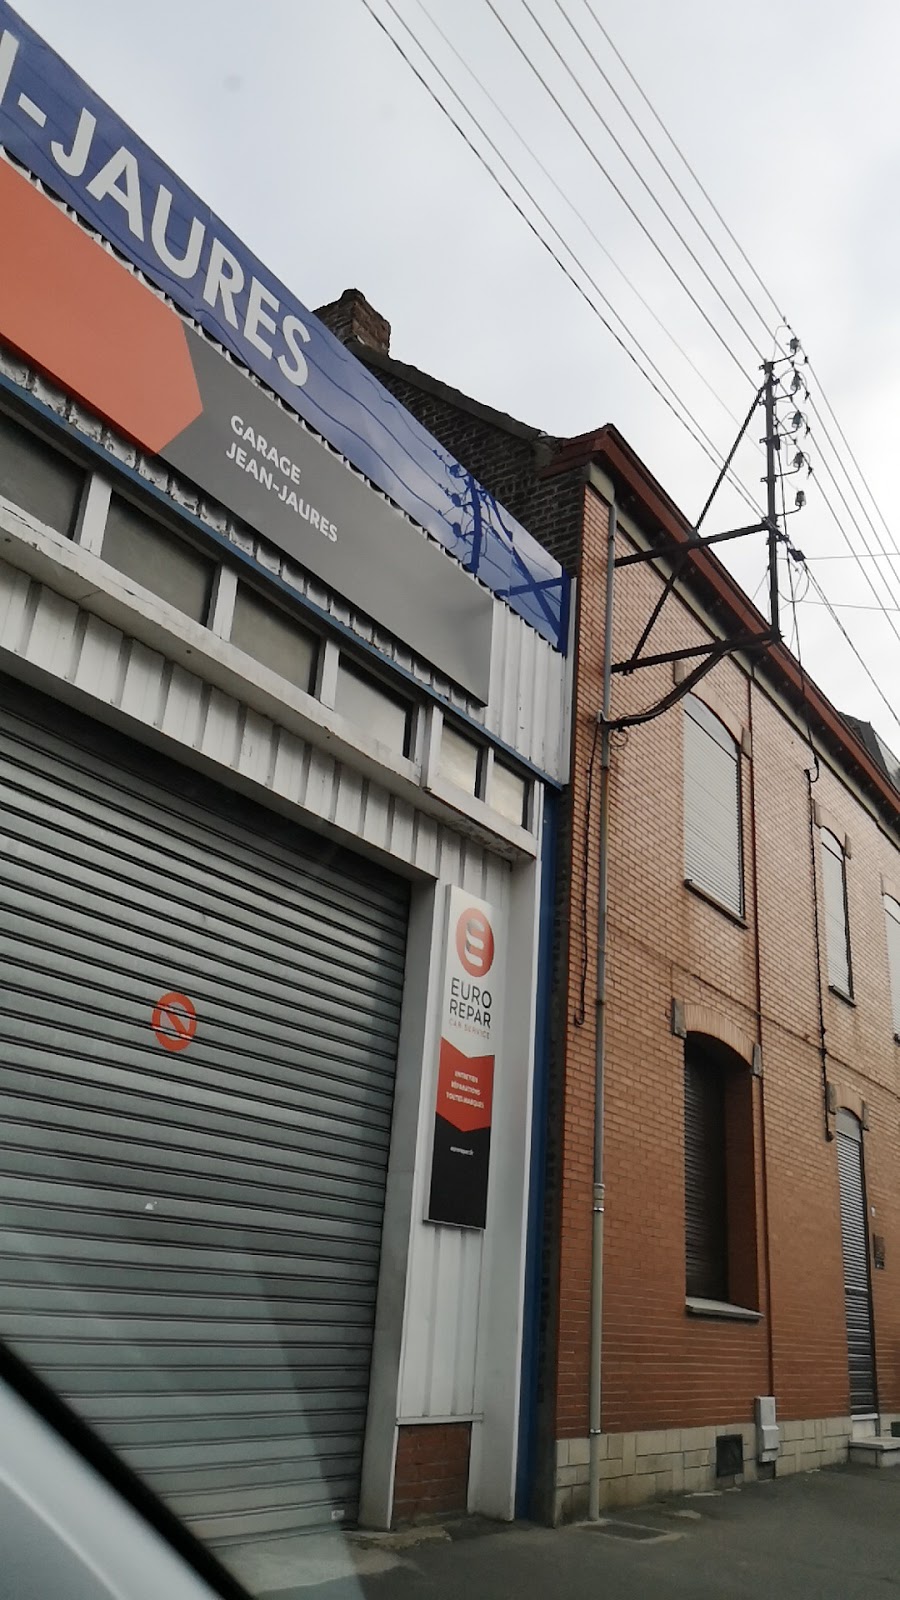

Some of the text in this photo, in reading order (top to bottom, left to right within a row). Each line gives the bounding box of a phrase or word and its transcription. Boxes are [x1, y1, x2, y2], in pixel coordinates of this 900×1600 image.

[230, 415, 301, 485] GARAGE
[225, 442, 338, 542] JEAN-JAURES
[449, 998, 491, 1029] REPAR
[451, 977, 492, 1008] EURO
